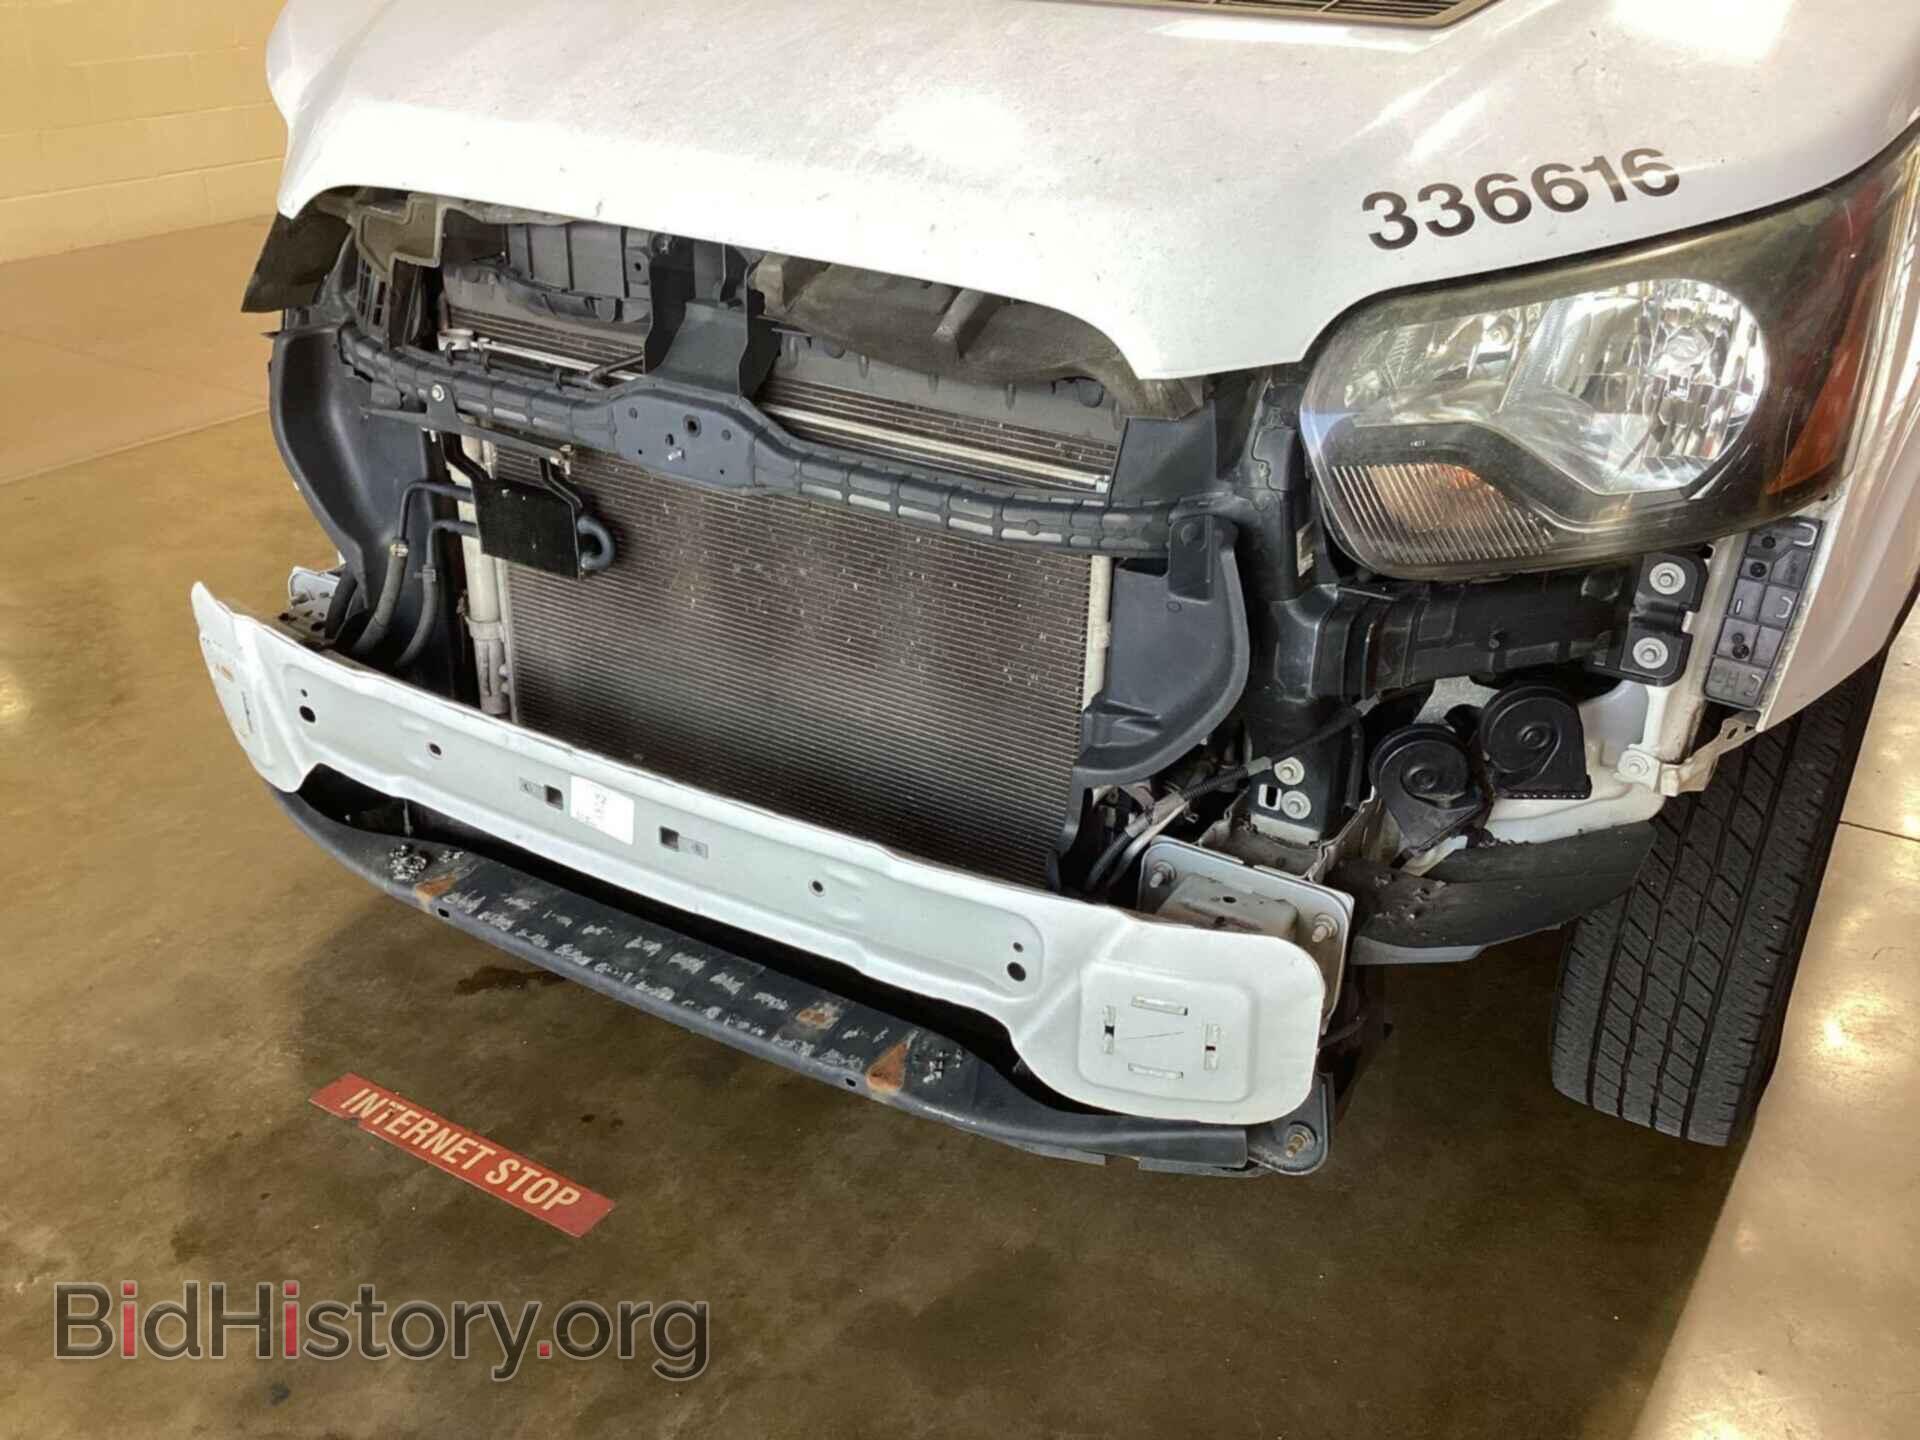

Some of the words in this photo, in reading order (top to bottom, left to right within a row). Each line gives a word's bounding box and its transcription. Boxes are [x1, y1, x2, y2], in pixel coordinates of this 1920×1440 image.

[1362, 148, 1680, 250] 336616
[340, 1088, 496, 1170] INTERNET
[485, 1159, 581, 1210] STOP
